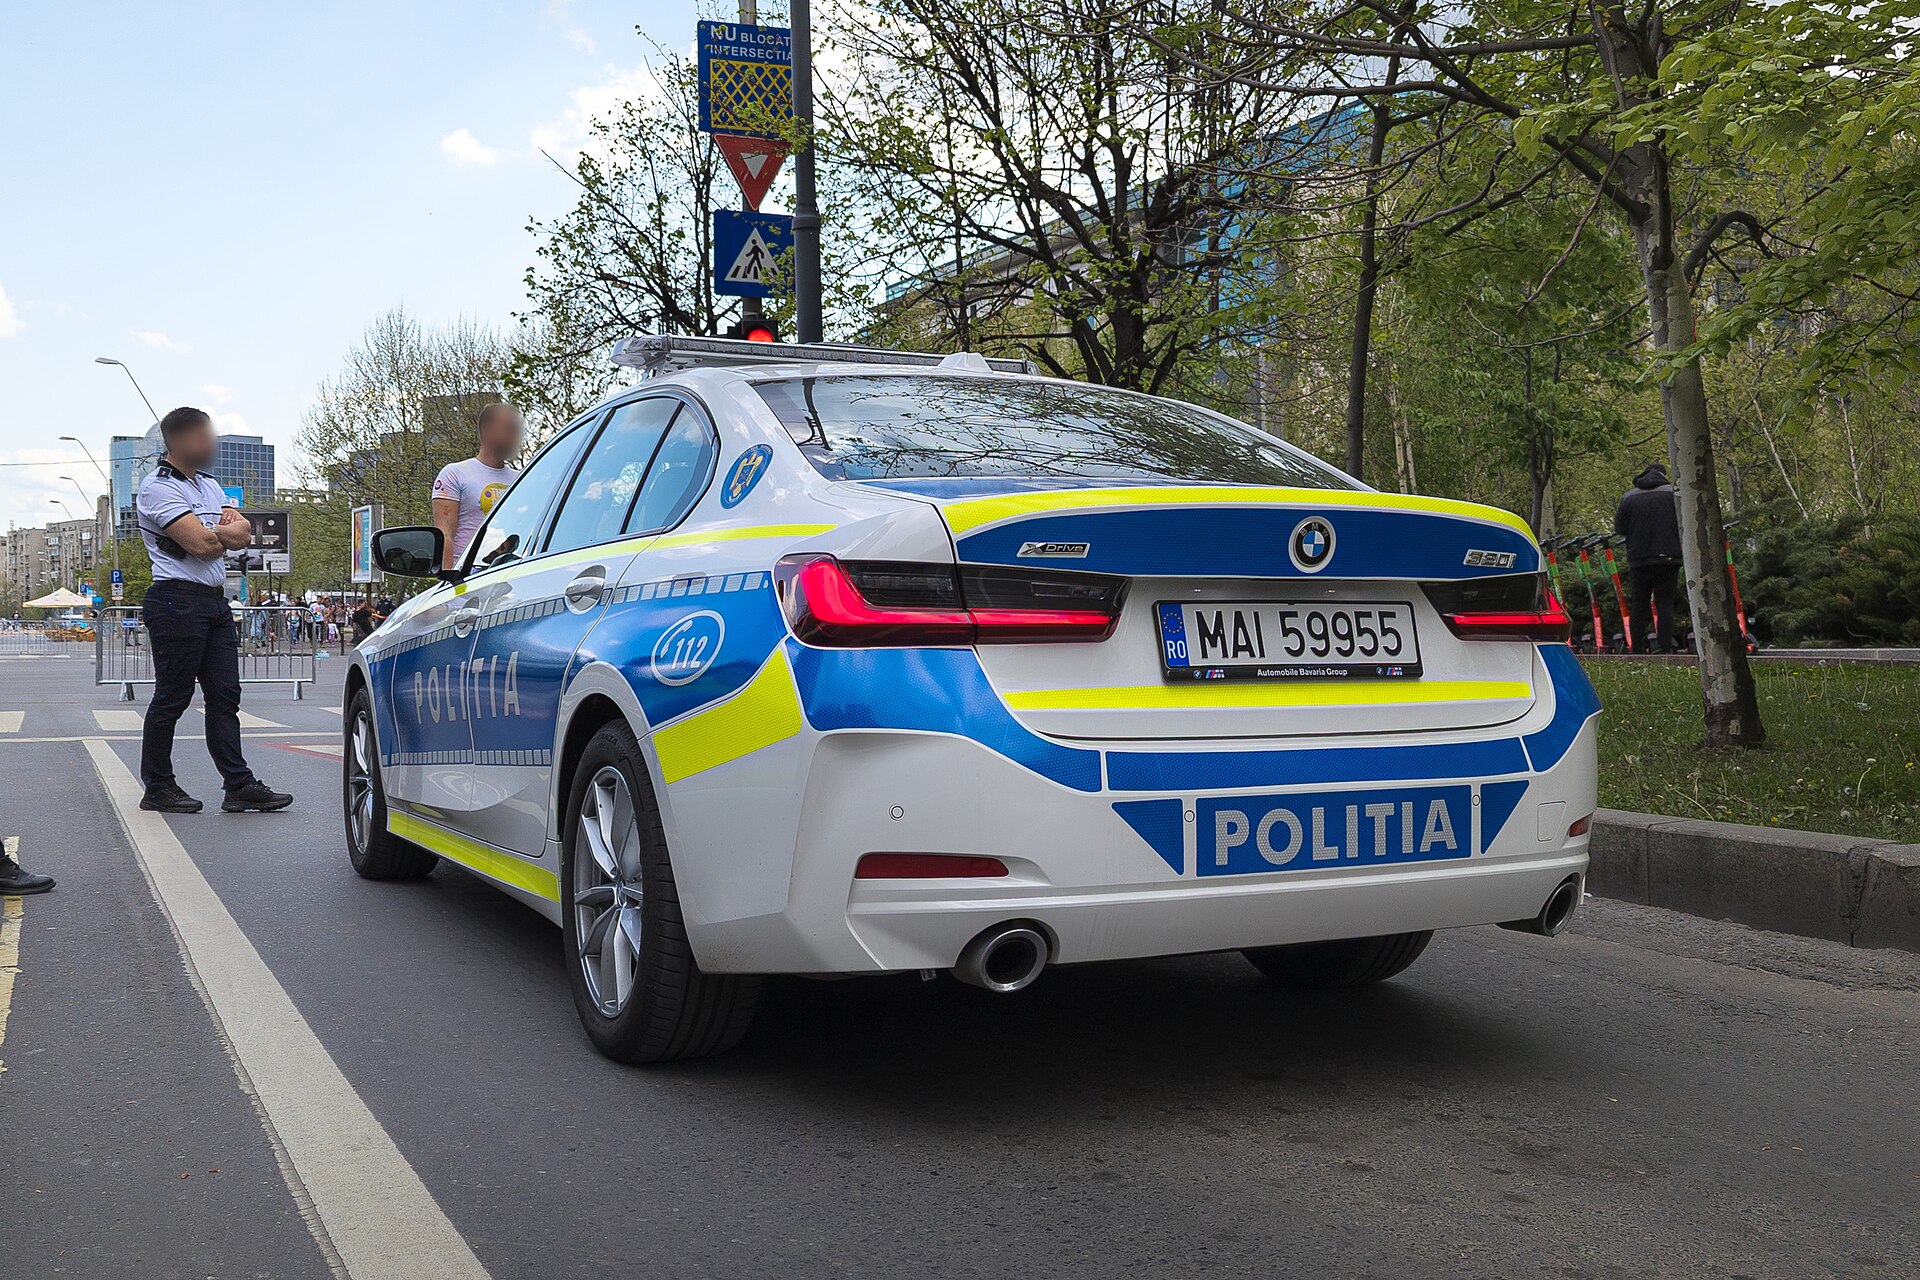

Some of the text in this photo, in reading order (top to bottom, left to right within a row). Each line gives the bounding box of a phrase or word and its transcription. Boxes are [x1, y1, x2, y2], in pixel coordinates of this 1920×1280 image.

[711, 25, 791, 47] NU BLOCAT
[1299, 522, 1329, 537] BMW
[1195, 610, 1402, 659] MAI 59955
[671, 635, 708, 669] 112
[1166, 640, 1187, 659] RO
[1257, 667, 1348, 677] Automobile Bavaria Group
[414, 651, 521, 724] POLITIA
[1215, 799, 1458, 866] POLITIA
